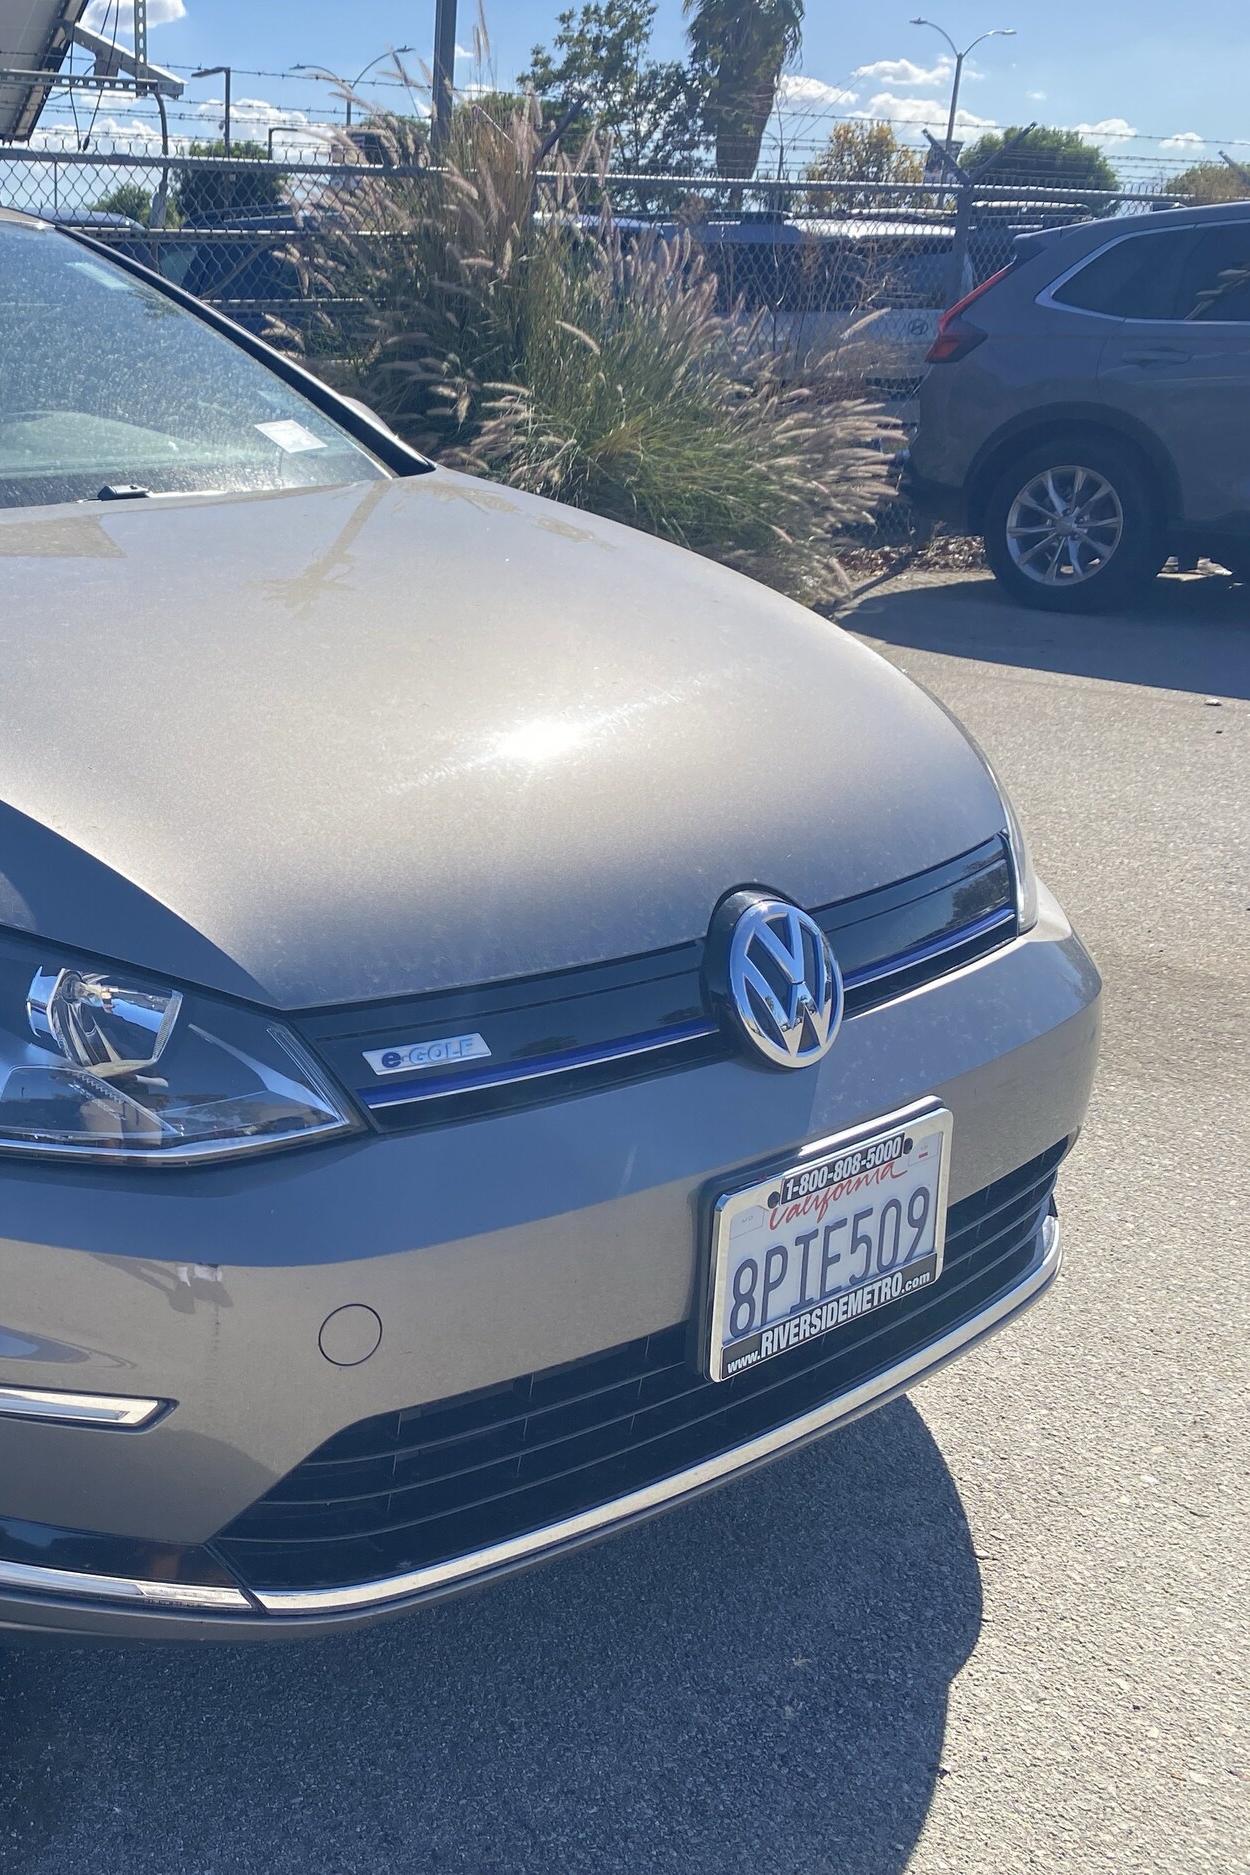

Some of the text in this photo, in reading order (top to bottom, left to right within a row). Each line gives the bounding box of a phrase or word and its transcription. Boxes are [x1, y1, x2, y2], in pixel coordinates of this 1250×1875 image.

[769, 1161, 908, 1230] California
[786, 1136, 903, 1200] 1-800-808-5000
[729, 1186, 931, 1338] 8PIE509
[727, 1270, 931, 1374] www.RIVERSIDEMETRO.com
